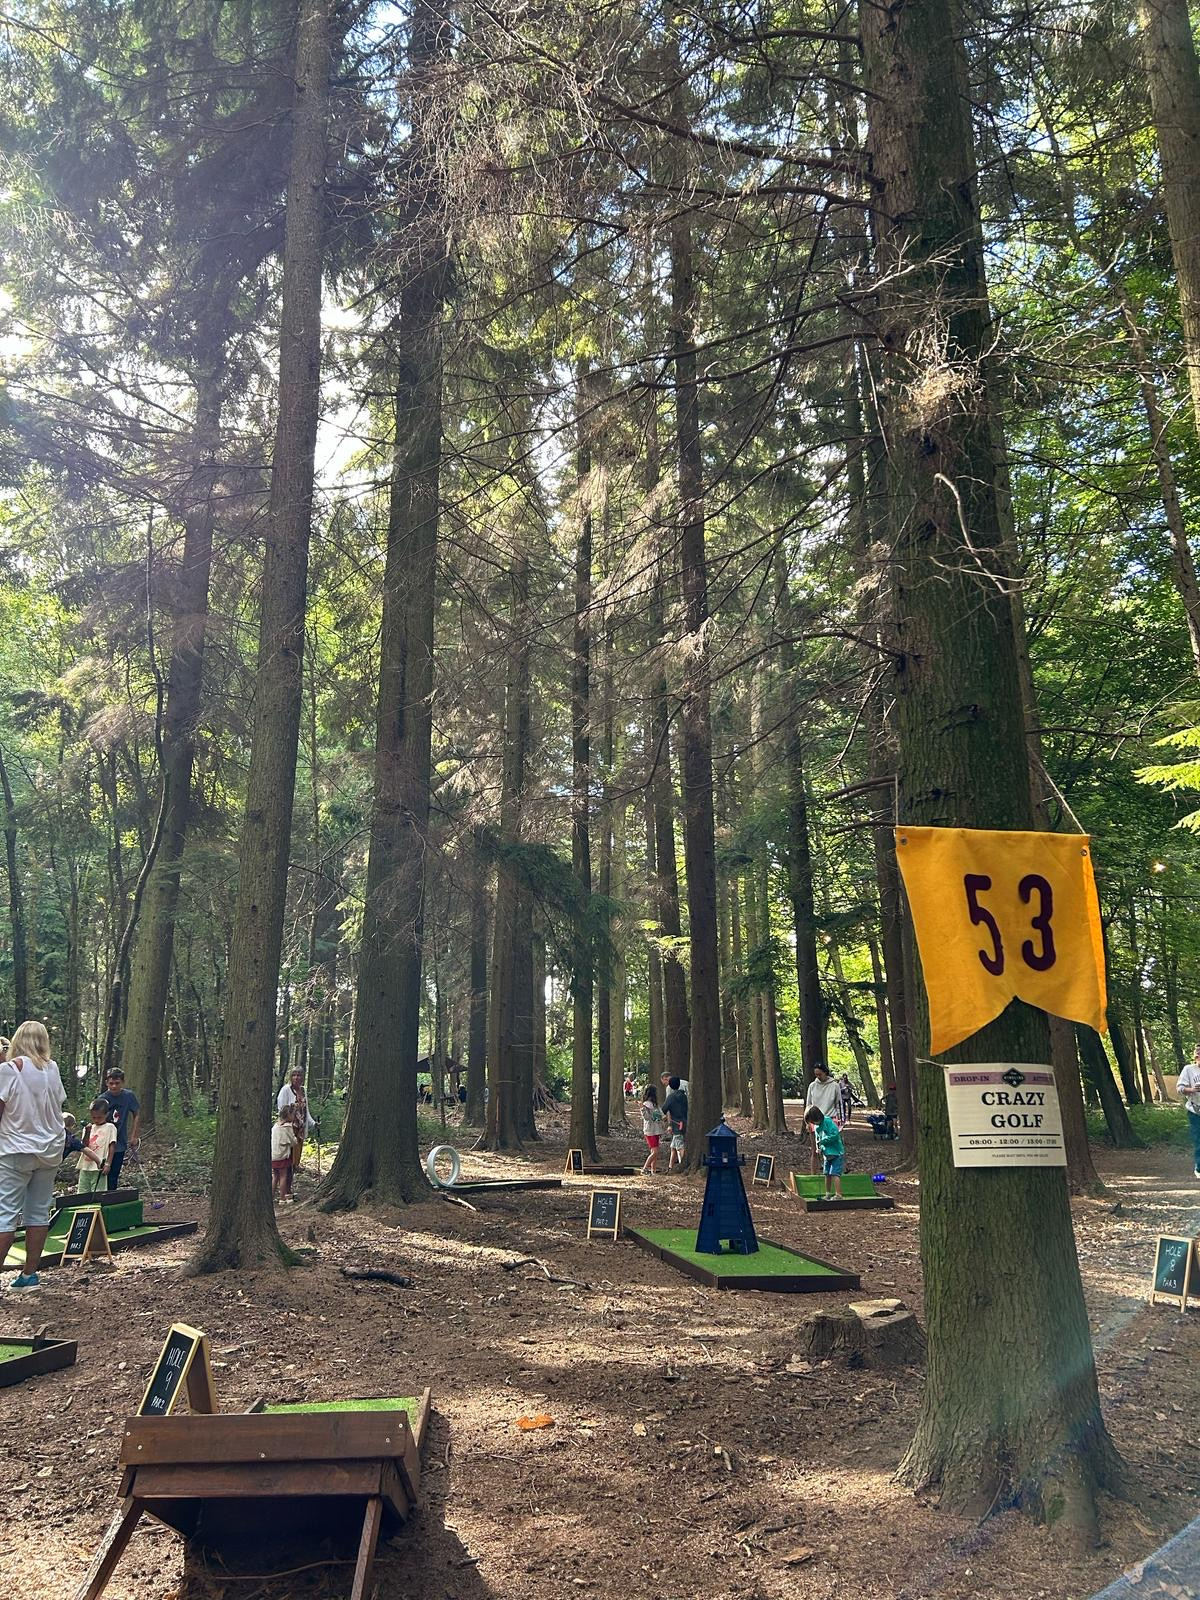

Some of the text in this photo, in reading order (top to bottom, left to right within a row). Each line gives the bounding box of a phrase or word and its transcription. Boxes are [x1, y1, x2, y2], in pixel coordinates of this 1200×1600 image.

[963, 873, 1056, 976] 53
[953, 1075, 990, 1083] DROP-IN
[981, 1091, 1045, 1106] CRAZY
[990, 1113, 1044, 1128] GOLF
[597, 1197, 613, 1206] HOLE
[76, 1217, 89, 1228] HOLE
[1165, 1244, 1182, 1257] HOLE
[1169, 1258, 1176, 1272] 8
[166, 1347, 187, 1369] HOLE
[165, 1370, 173, 1391] 9
